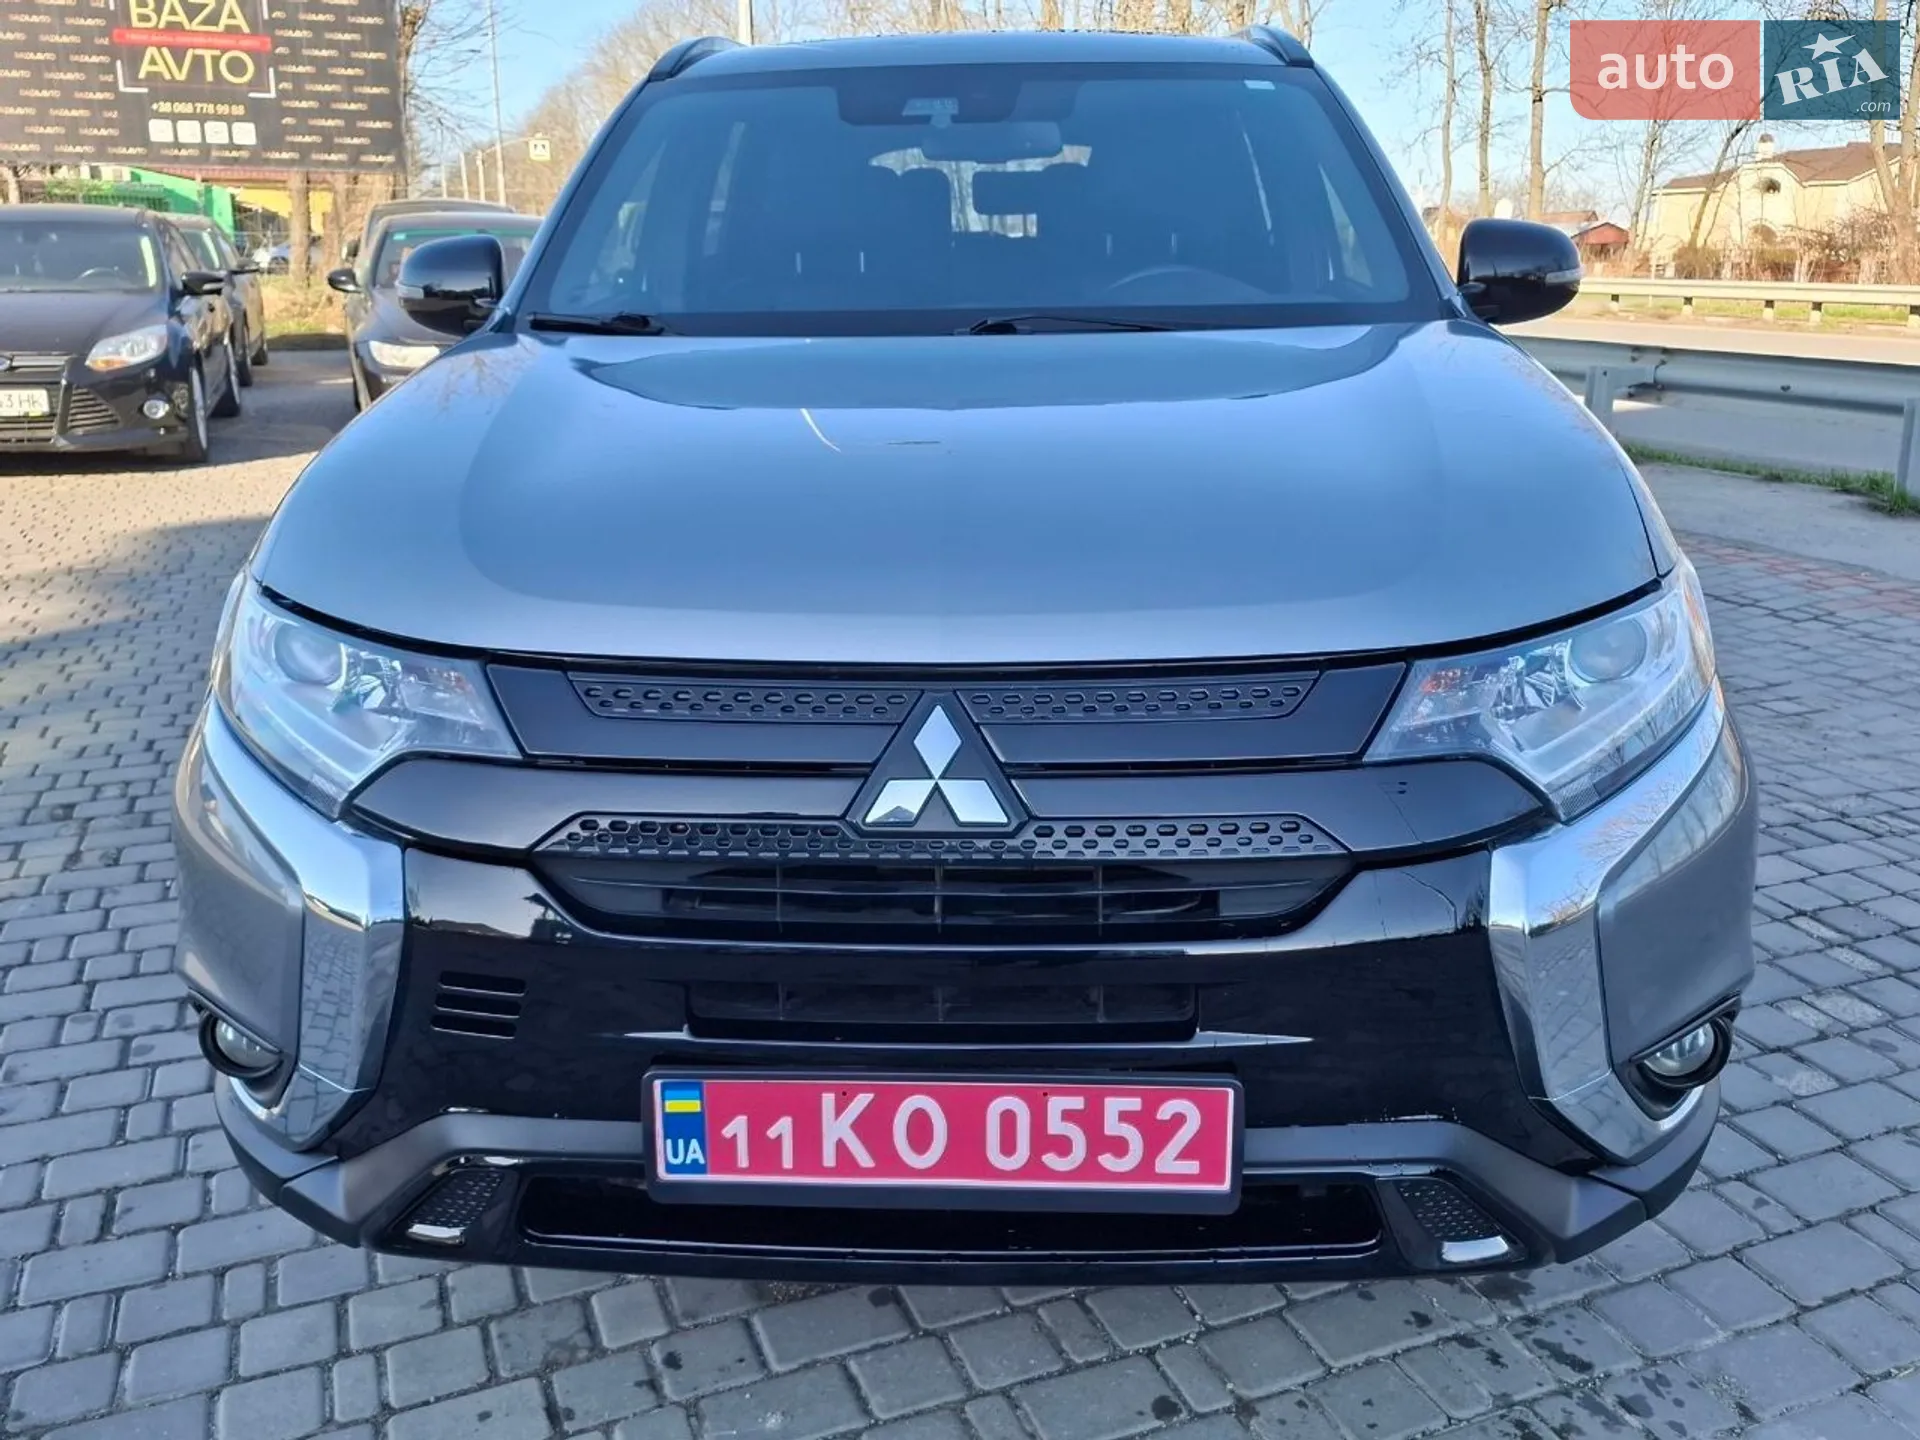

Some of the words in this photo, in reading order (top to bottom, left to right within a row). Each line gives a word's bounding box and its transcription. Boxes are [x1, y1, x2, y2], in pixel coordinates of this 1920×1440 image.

[129, 0, 250, 33] BAZA
[138, 47, 255, 84] AVTO
[665, 1137, 705, 1164] UA
[985, 1095, 1200, 1174] 0552
